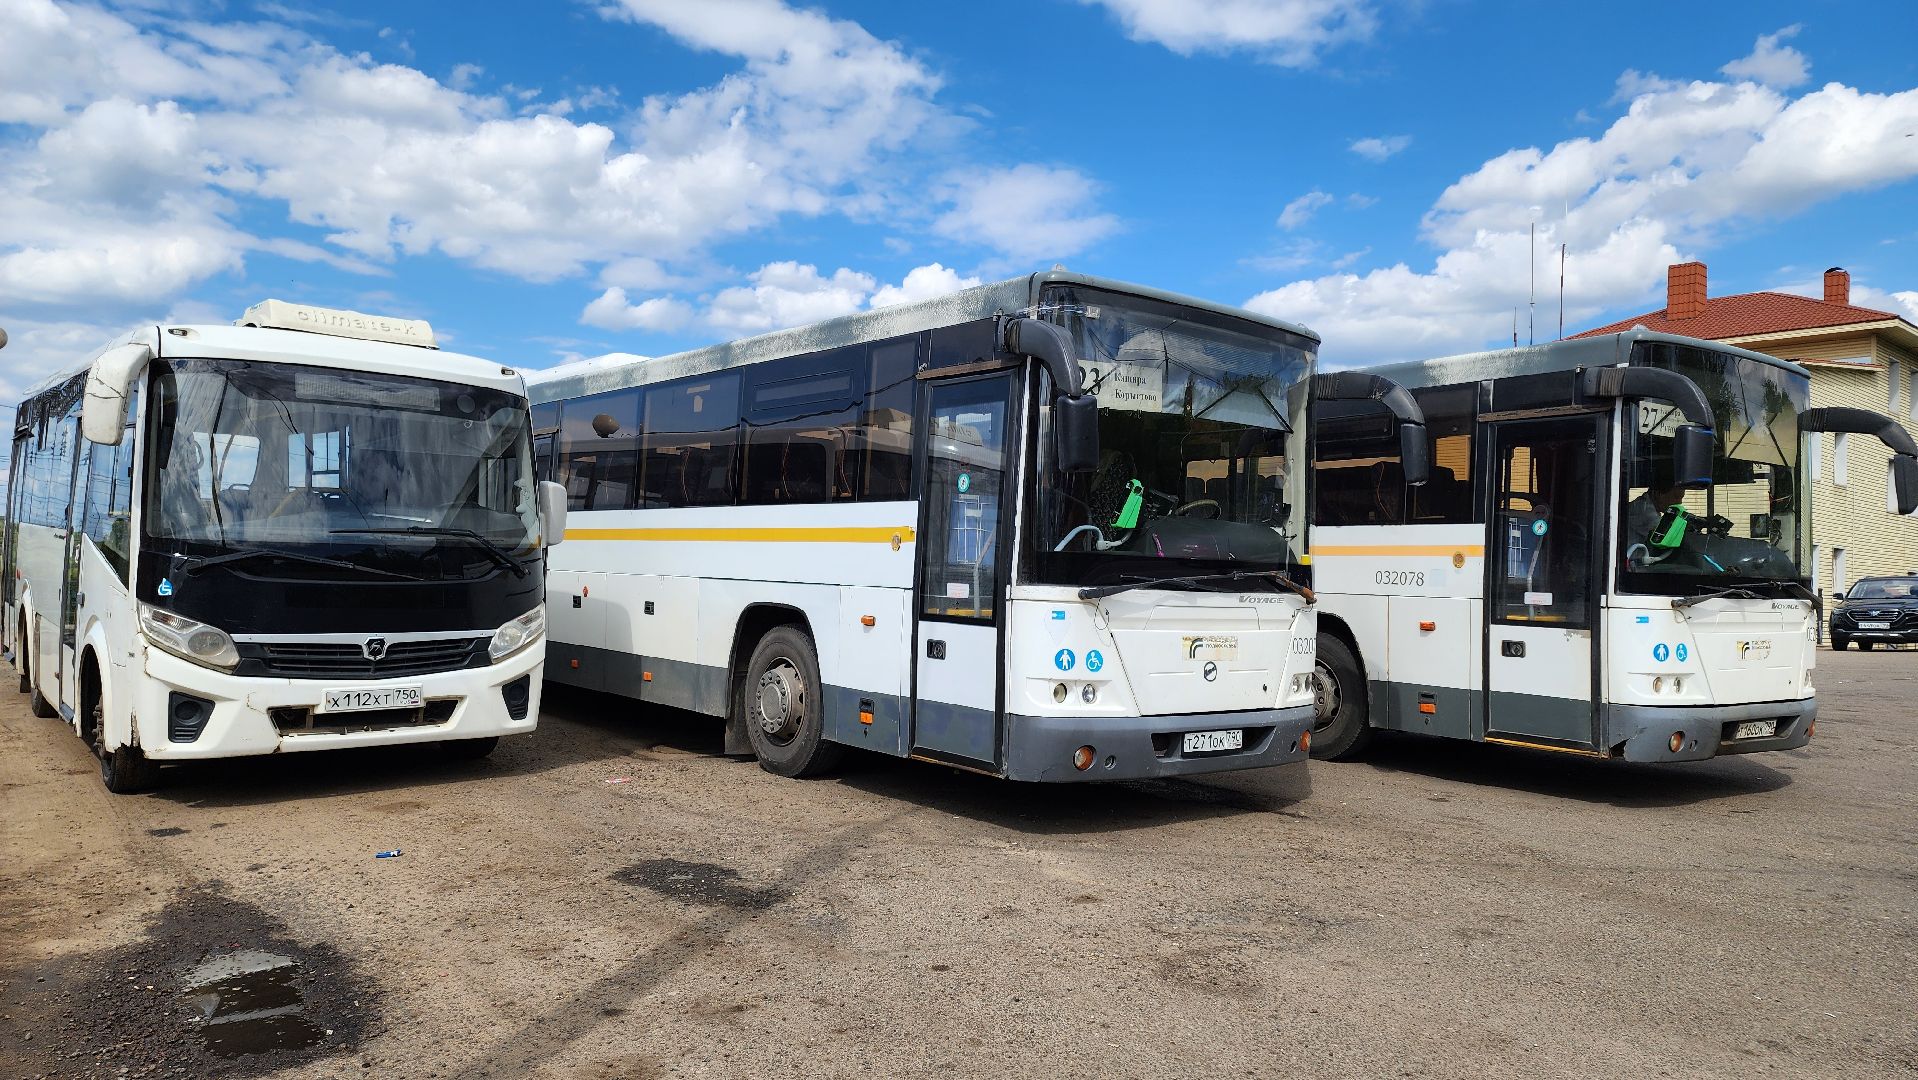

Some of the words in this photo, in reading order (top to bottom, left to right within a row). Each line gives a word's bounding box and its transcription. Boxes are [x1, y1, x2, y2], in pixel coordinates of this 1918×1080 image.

[1641, 406, 1659, 428] 27
[1375, 570, 1425, 586] 032078
[395, 689, 417, 701] 750
